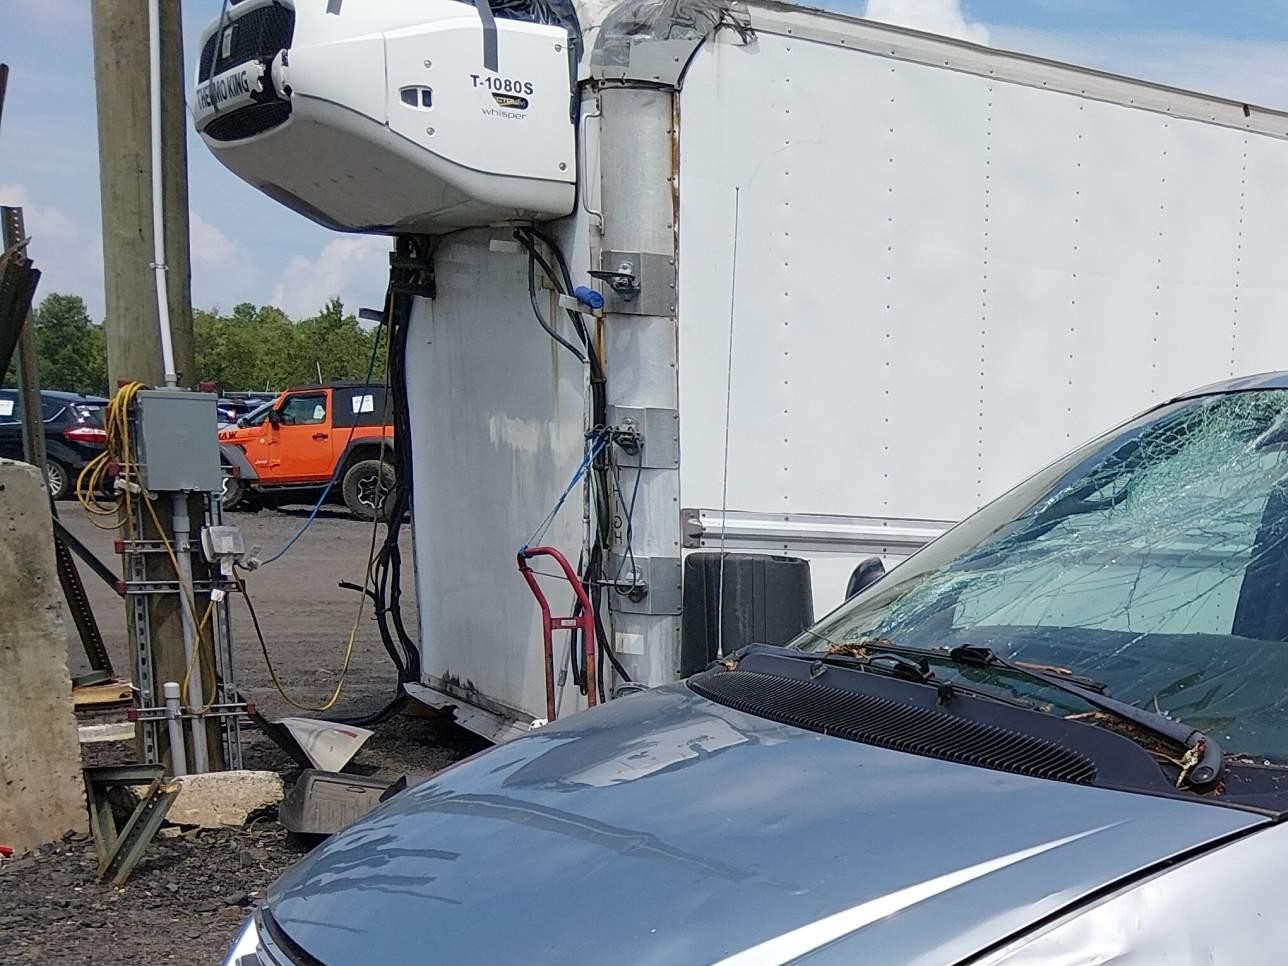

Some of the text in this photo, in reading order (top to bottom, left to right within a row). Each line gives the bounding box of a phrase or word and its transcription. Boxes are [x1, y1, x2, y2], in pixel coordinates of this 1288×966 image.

[227, 71, 249, 97] KING
[470, 74, 533, 95] T-1080S
[482, 109, 526, 120] whisper
